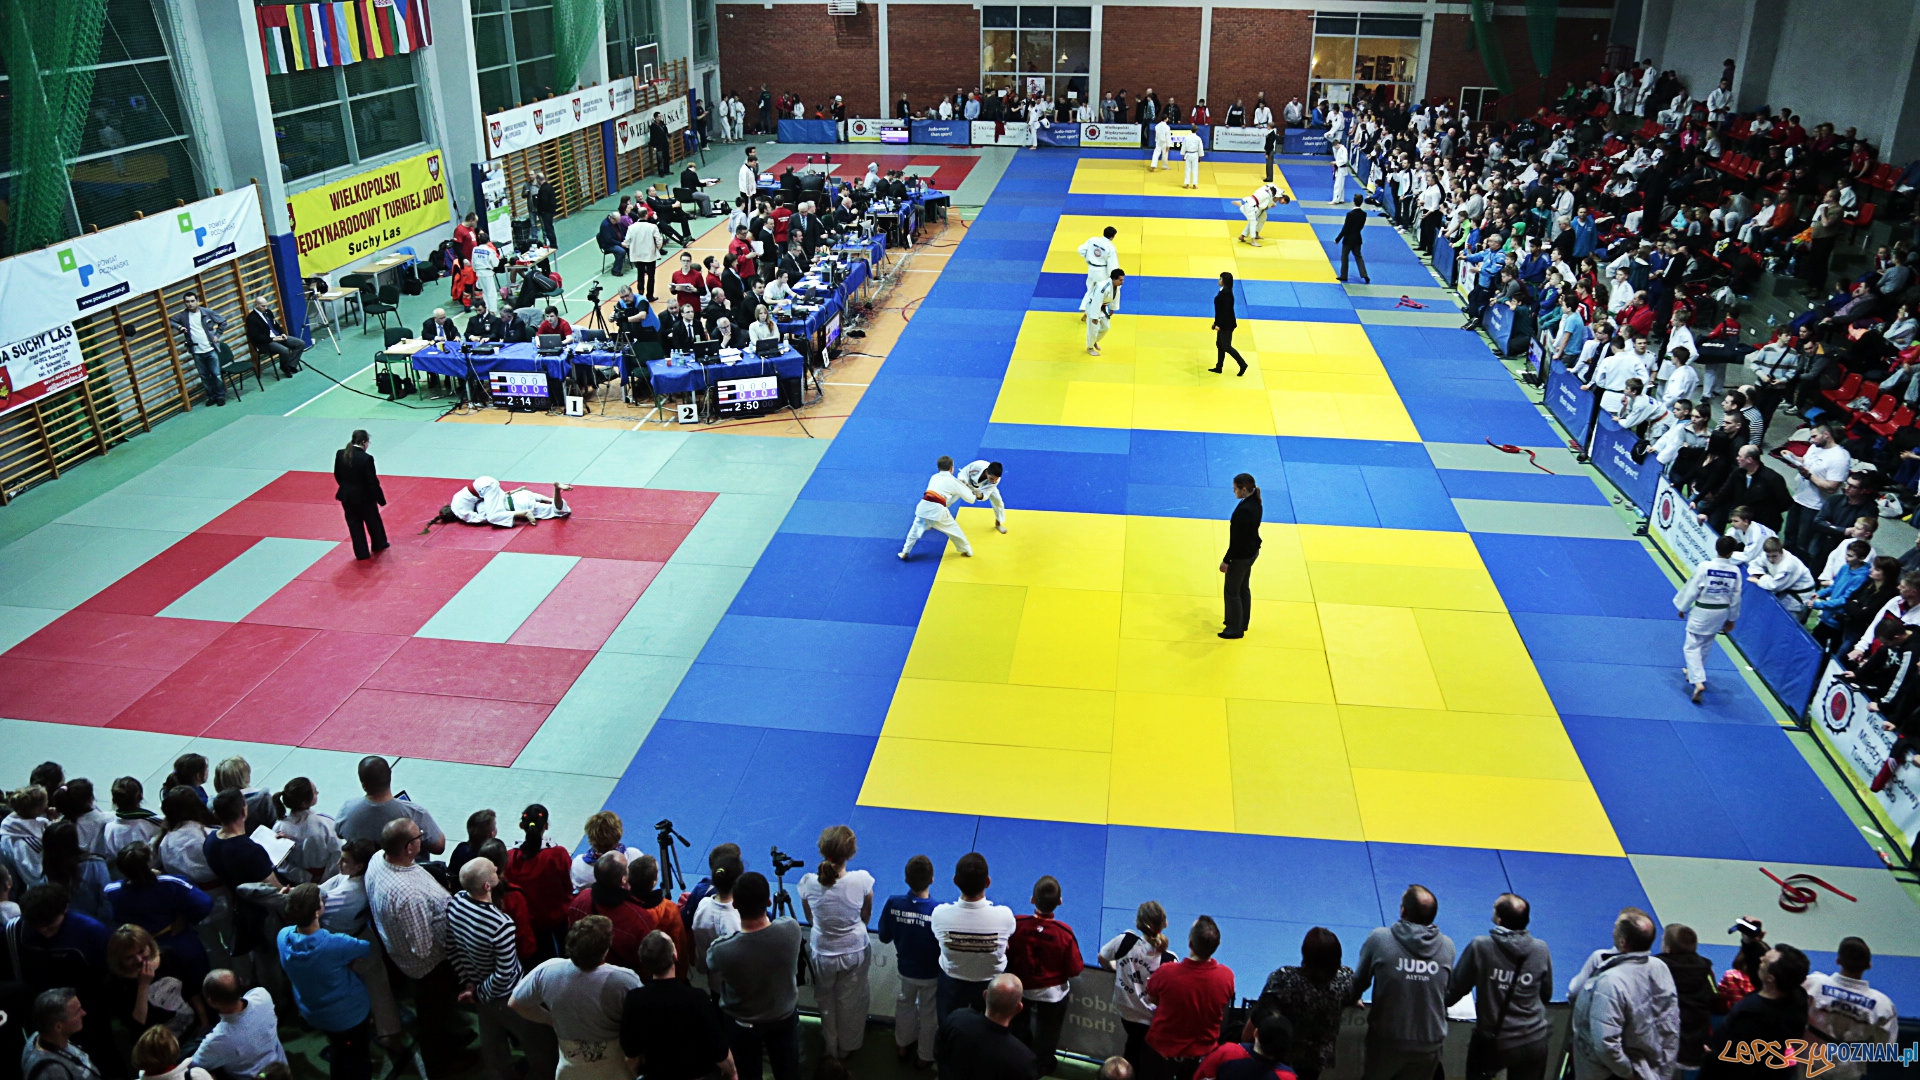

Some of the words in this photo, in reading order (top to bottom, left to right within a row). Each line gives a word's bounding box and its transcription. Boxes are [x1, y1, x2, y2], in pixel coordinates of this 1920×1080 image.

[329, 171, 401, 211] WIELKOPOLSKI
[294, 205, 381, 257] IĘDZYNARODOWY
[383, 192, 421, 220] TURNIEJ
[423, 183, 444, 206] JUDO
[348, 235, 381, 255] Suchy
[383, 226, 401, 241] Las
[97, 255, 117, 267] POWIAT
[11, 333, 46, 359] SUCHY
[48, 325, 73, 343] LAS
[507, 396, 531, 406] 2:14
[572, 400, 577, 412] 1
[734, 400, 759, 411] 2:50
[683, 406, 694, 420] 2
[1395, 957, 1439, 975] JUDO
